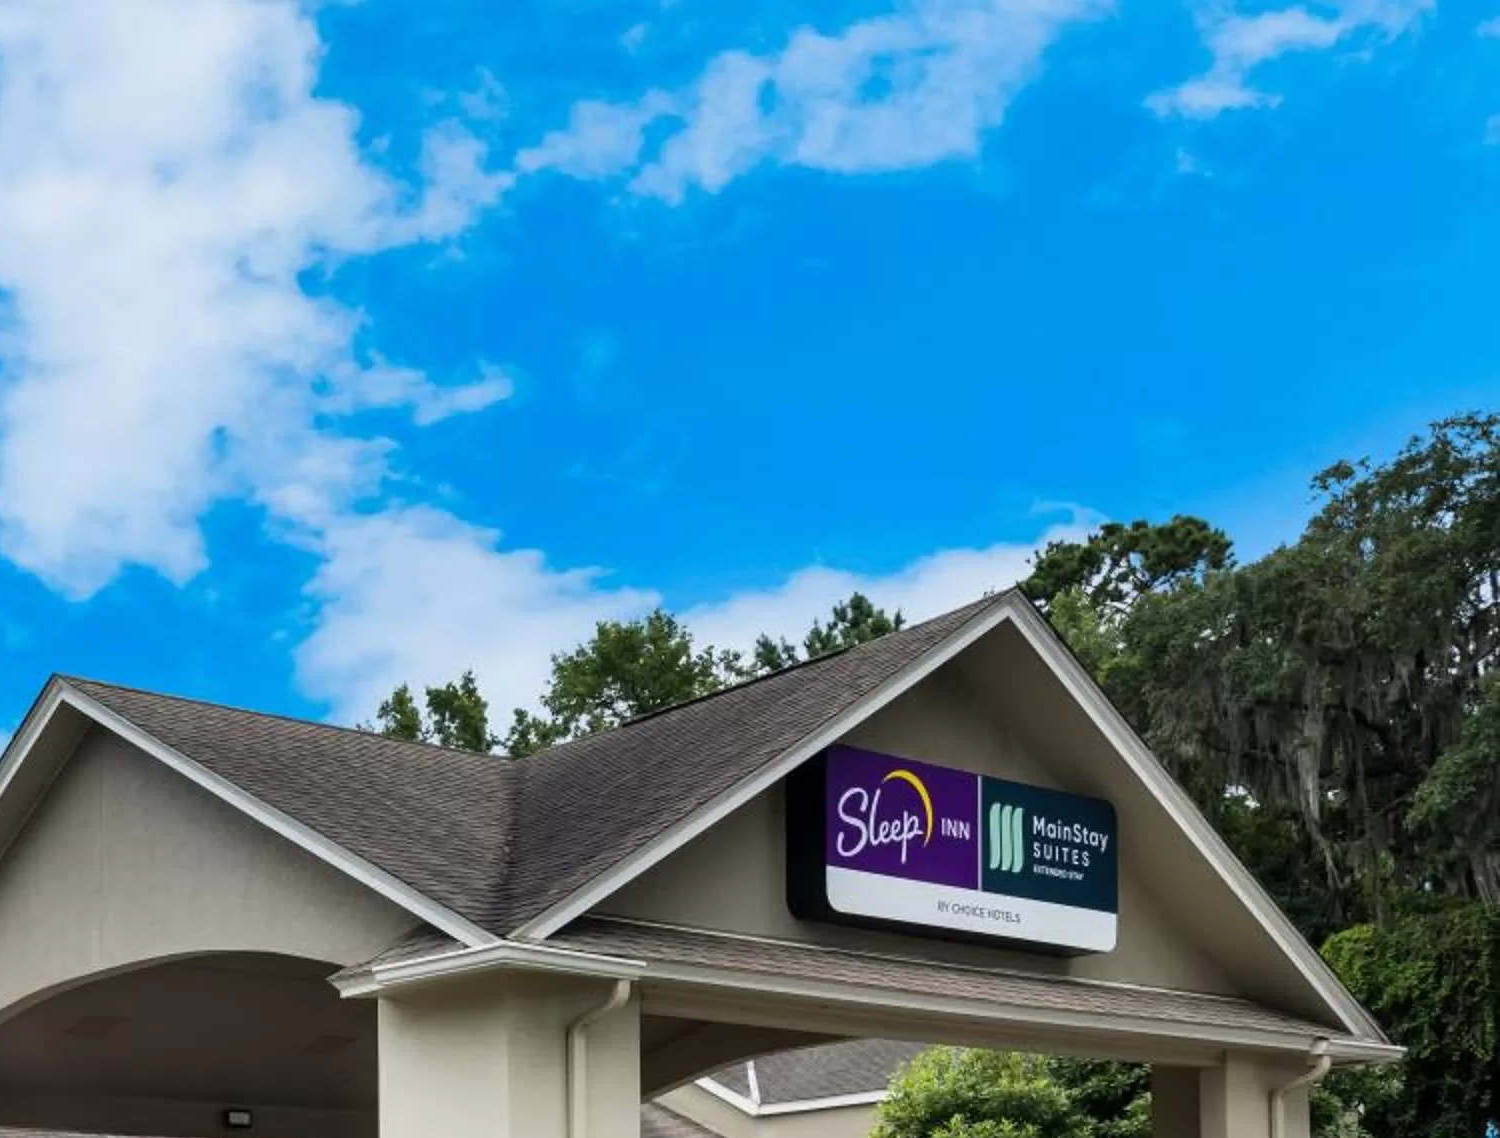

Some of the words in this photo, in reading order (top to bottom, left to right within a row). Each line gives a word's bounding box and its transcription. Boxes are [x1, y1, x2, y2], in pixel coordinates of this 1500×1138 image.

[836, 786, 924, 865] Sleep
[941, 817, 970, 841] INN
[1033, 815, 1109, 853] MainStay
[1033, 841, 1090, 867] SUITES
